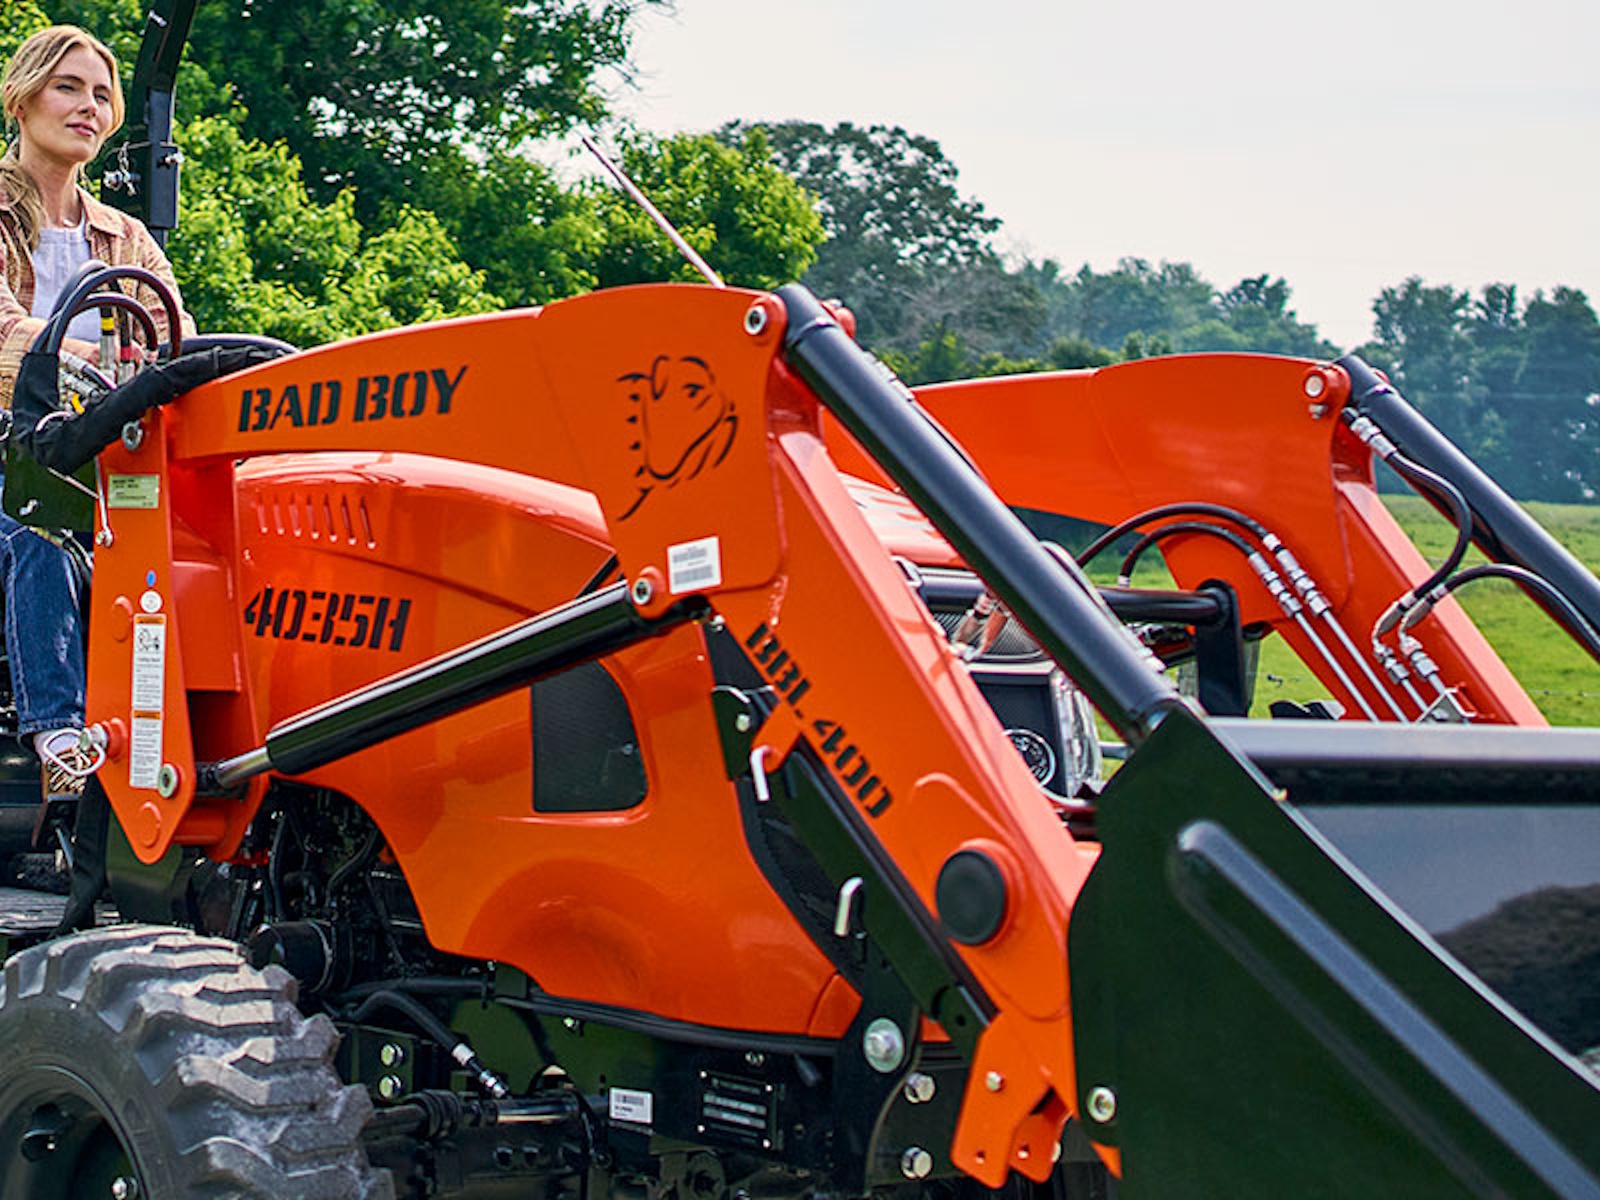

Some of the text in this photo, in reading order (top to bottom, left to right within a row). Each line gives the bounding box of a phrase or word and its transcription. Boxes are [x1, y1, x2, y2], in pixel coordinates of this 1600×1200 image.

[238, 365, 468, 432] BAD BOY
[244, 586, 412, 652] 4035H
[746, 623, 892, 818] BBL 400
